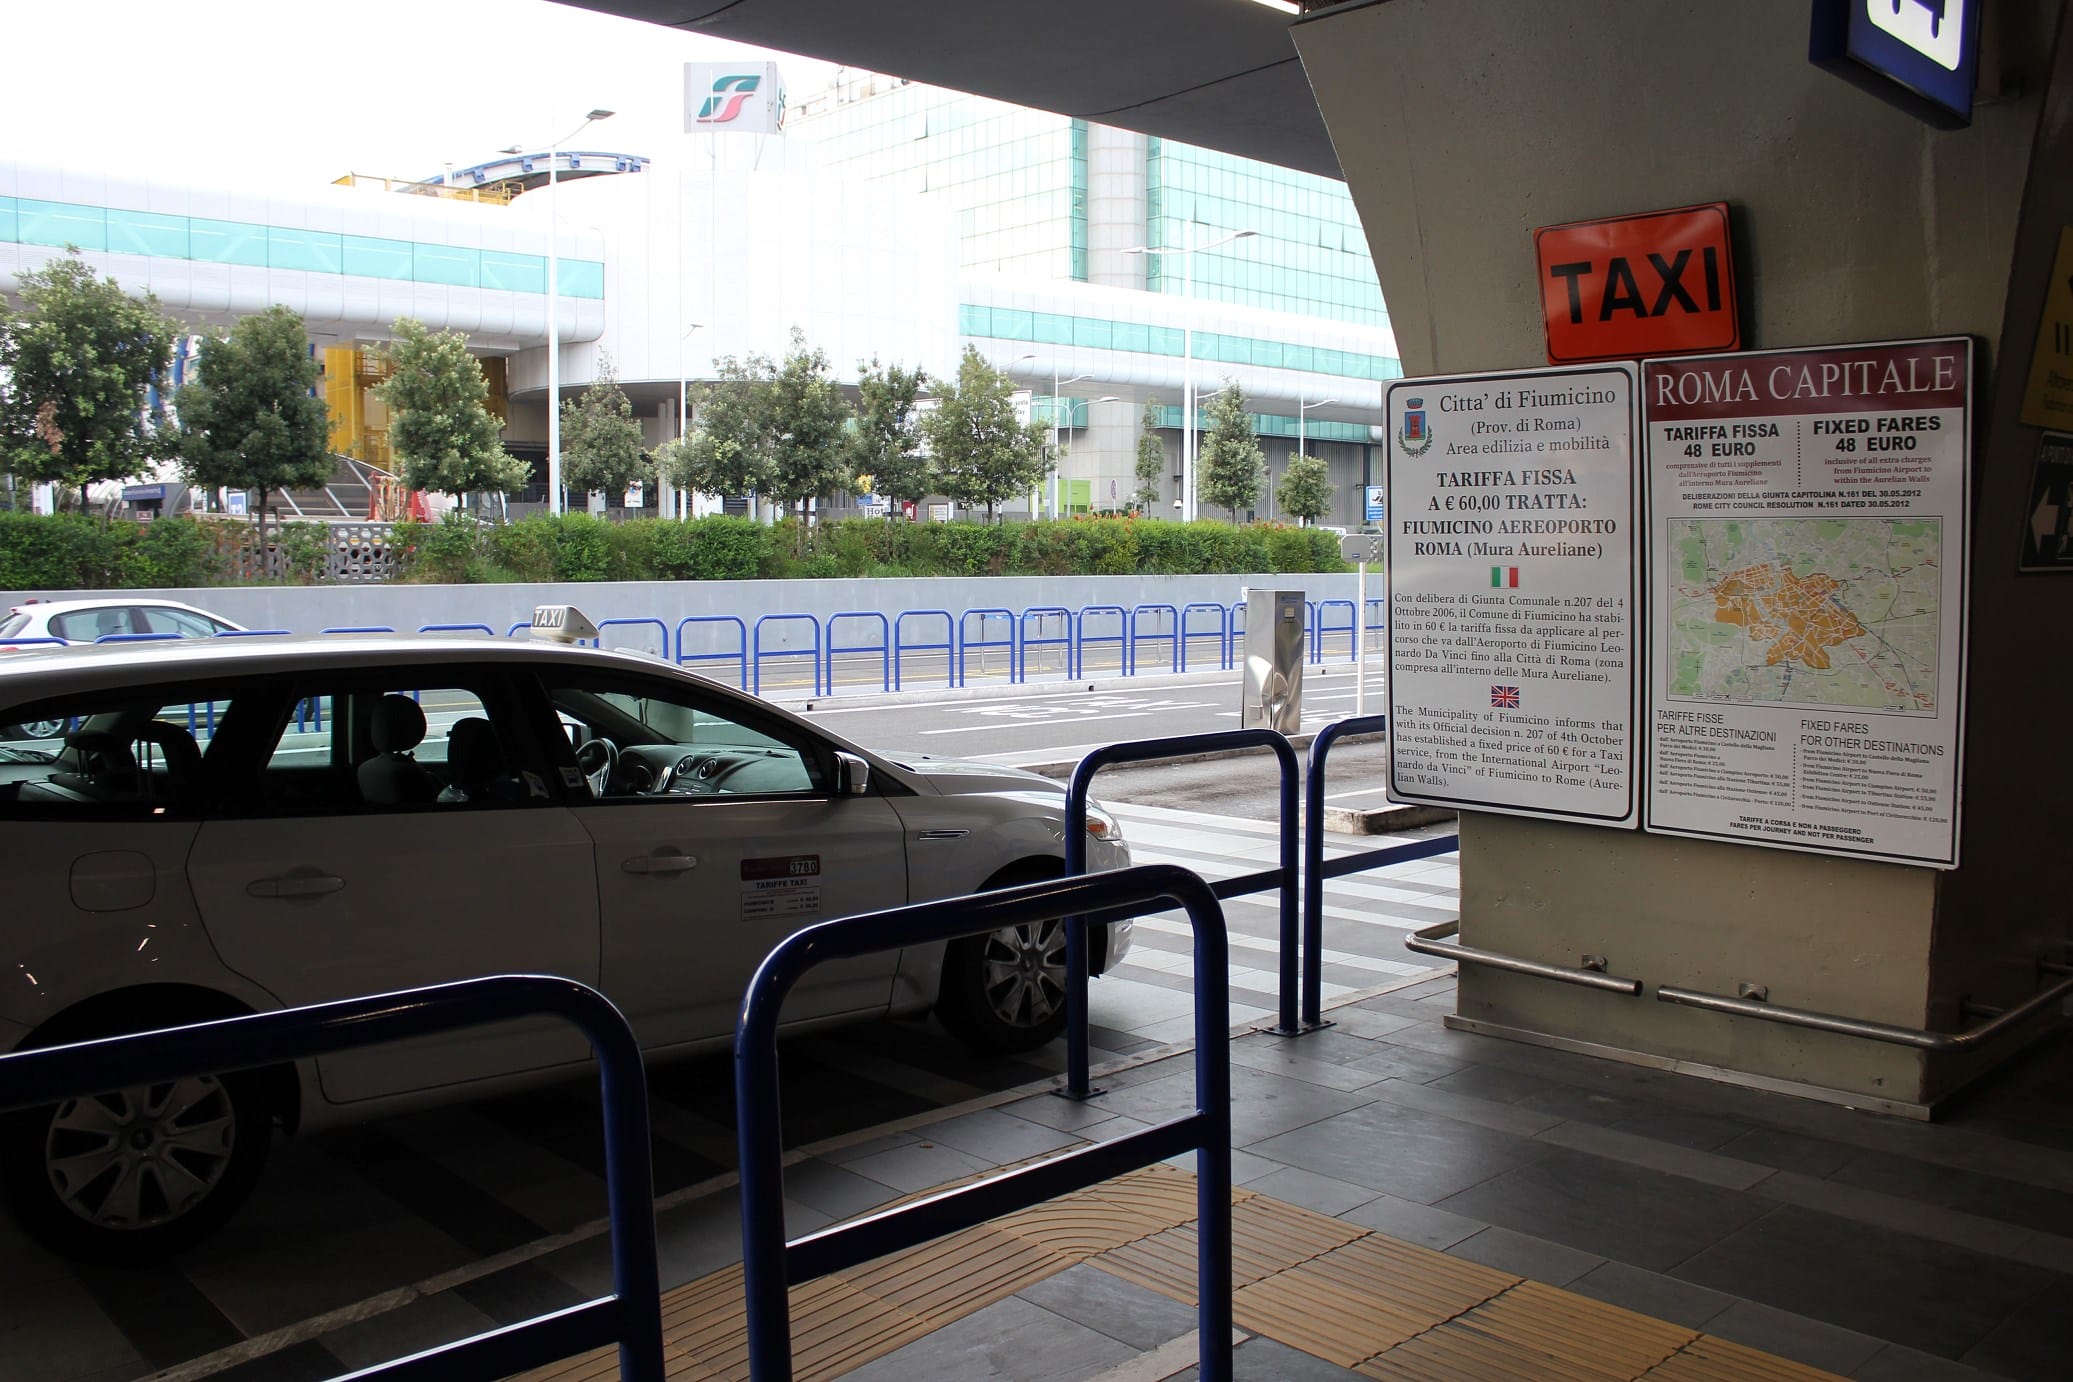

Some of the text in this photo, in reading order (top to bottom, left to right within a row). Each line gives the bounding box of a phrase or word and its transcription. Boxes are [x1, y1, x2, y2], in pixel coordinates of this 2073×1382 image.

[1550, 246, 1722, 325] TAXI
[1656, 356, 1956, 405] ROMA CAPITALE
[1495, 391, 1512, 409] di
[1518, 387, 1616, 408] Fiumicino
[1471, 417, 1581, 436] (Prov. di Roma)
[1664, 423, 1780, 441] TARIFFA FISSA
[1813, 416, 1941, 435] FIXED FARES
[1446, 436, 1610, 455] Area edilizia e mobilità
[1684, 442, 1756, 458] 48 EURO
[1835, 436, 1917, 452] 48 EURO
[1436, 469, 1577, 487] TARIFFA FISSA
[1428, 494, 1586, 512] A € 60,00 TRATTA:
[1862, 490, 1877, 498] DEL
[1693, 502, 1713, 510] ROME
[1766, 501, 1814, 509] RESOLUTION
[1868, 500, 1910, 508] 30.05.2012
[1403, 519, 1616, 534] FIUMICINO AEREOPORTO
[1415, 542, 1602, 559] ROMA (Mura Aureliane)
[1394, 593, 1624, 608] Con delibera di Giunta Comunale n.207 del 4
[534, 609, 563, 627] TAXI
[1395, 607, 1624, 623] Ottobre 2006, il Comune di Fiumicino ha stabi-
[1395, 620, 1624, 639] lito in 60 € la tariffa fissa da applicare al per-
[1394, 636, 1419, 645] corso
[1421, 636, 1438, 645] che
[1530, 639, 1541, 649] di
[1544, 640, 1597, 652] Fiumicino
[1600, 642, 1624, 653] Leo-
[1395, 649, 1624, 668] nardo Da Vinci fino alla Città di Roma (zona
[1395, 663, 1439, 673] compresa
[1493, 666, 1519, 677] delle
[1521, 668, 1548, 679] Mura
[1551, 670, 1611, 682] Aureliane).
[1395, 705, 1624, 731] The Municipality of Fiumicino informs that
[1657, 710, 1724, 724] TARIFFE FISSE
[1396, 720, 1624, 746] with its Official decision n. 207 of 4th October
[1657, 723, 1776, 741] PER ALTRE DESTINAZIONI
[1801, 719, 1869, 734] FIXED FARES
[1396, 732, 1412, 742] has
[1414, 735, 1467, 747] established
[1479, 739, 1503, 750] fixed
[1506, 742, 1532, 753] price
[1534, 744, 1545, 754] of
[1547, 745, 1560, 755] 60
[1562, 746, 1569, 756] €
[1572, 747, 1587, 758] for
[1599, 749, 1623, 761] Taxi
[1801, 734, 1944, 756] FOR OTHER DESTINATIONS
[1397, 748, 1432, 760] service,
[1436, 750, 1458, 760] from
[1462, 752, 1478, 762] the
[1482, 753, 1547, 768] International
[1551, 760, 1589, 772] Airport
[1397, 761, 1424, 771] nardo
[1426, 763, 1438, 772] da
[1475, 767, 1485, 776] of
[1488, 768, 1538, 781] Fiumicino
[1542, 775, 1552, 783] to
[1555, 774, 1586, 786] Rome
[1589, 778, 1623, 790] (Aure-
[1397, 773, 1449, 787] lian Walls).
[791, 861, 817, 874] 3780
[756, 878, 809, 890] TARIFFE TAXI
